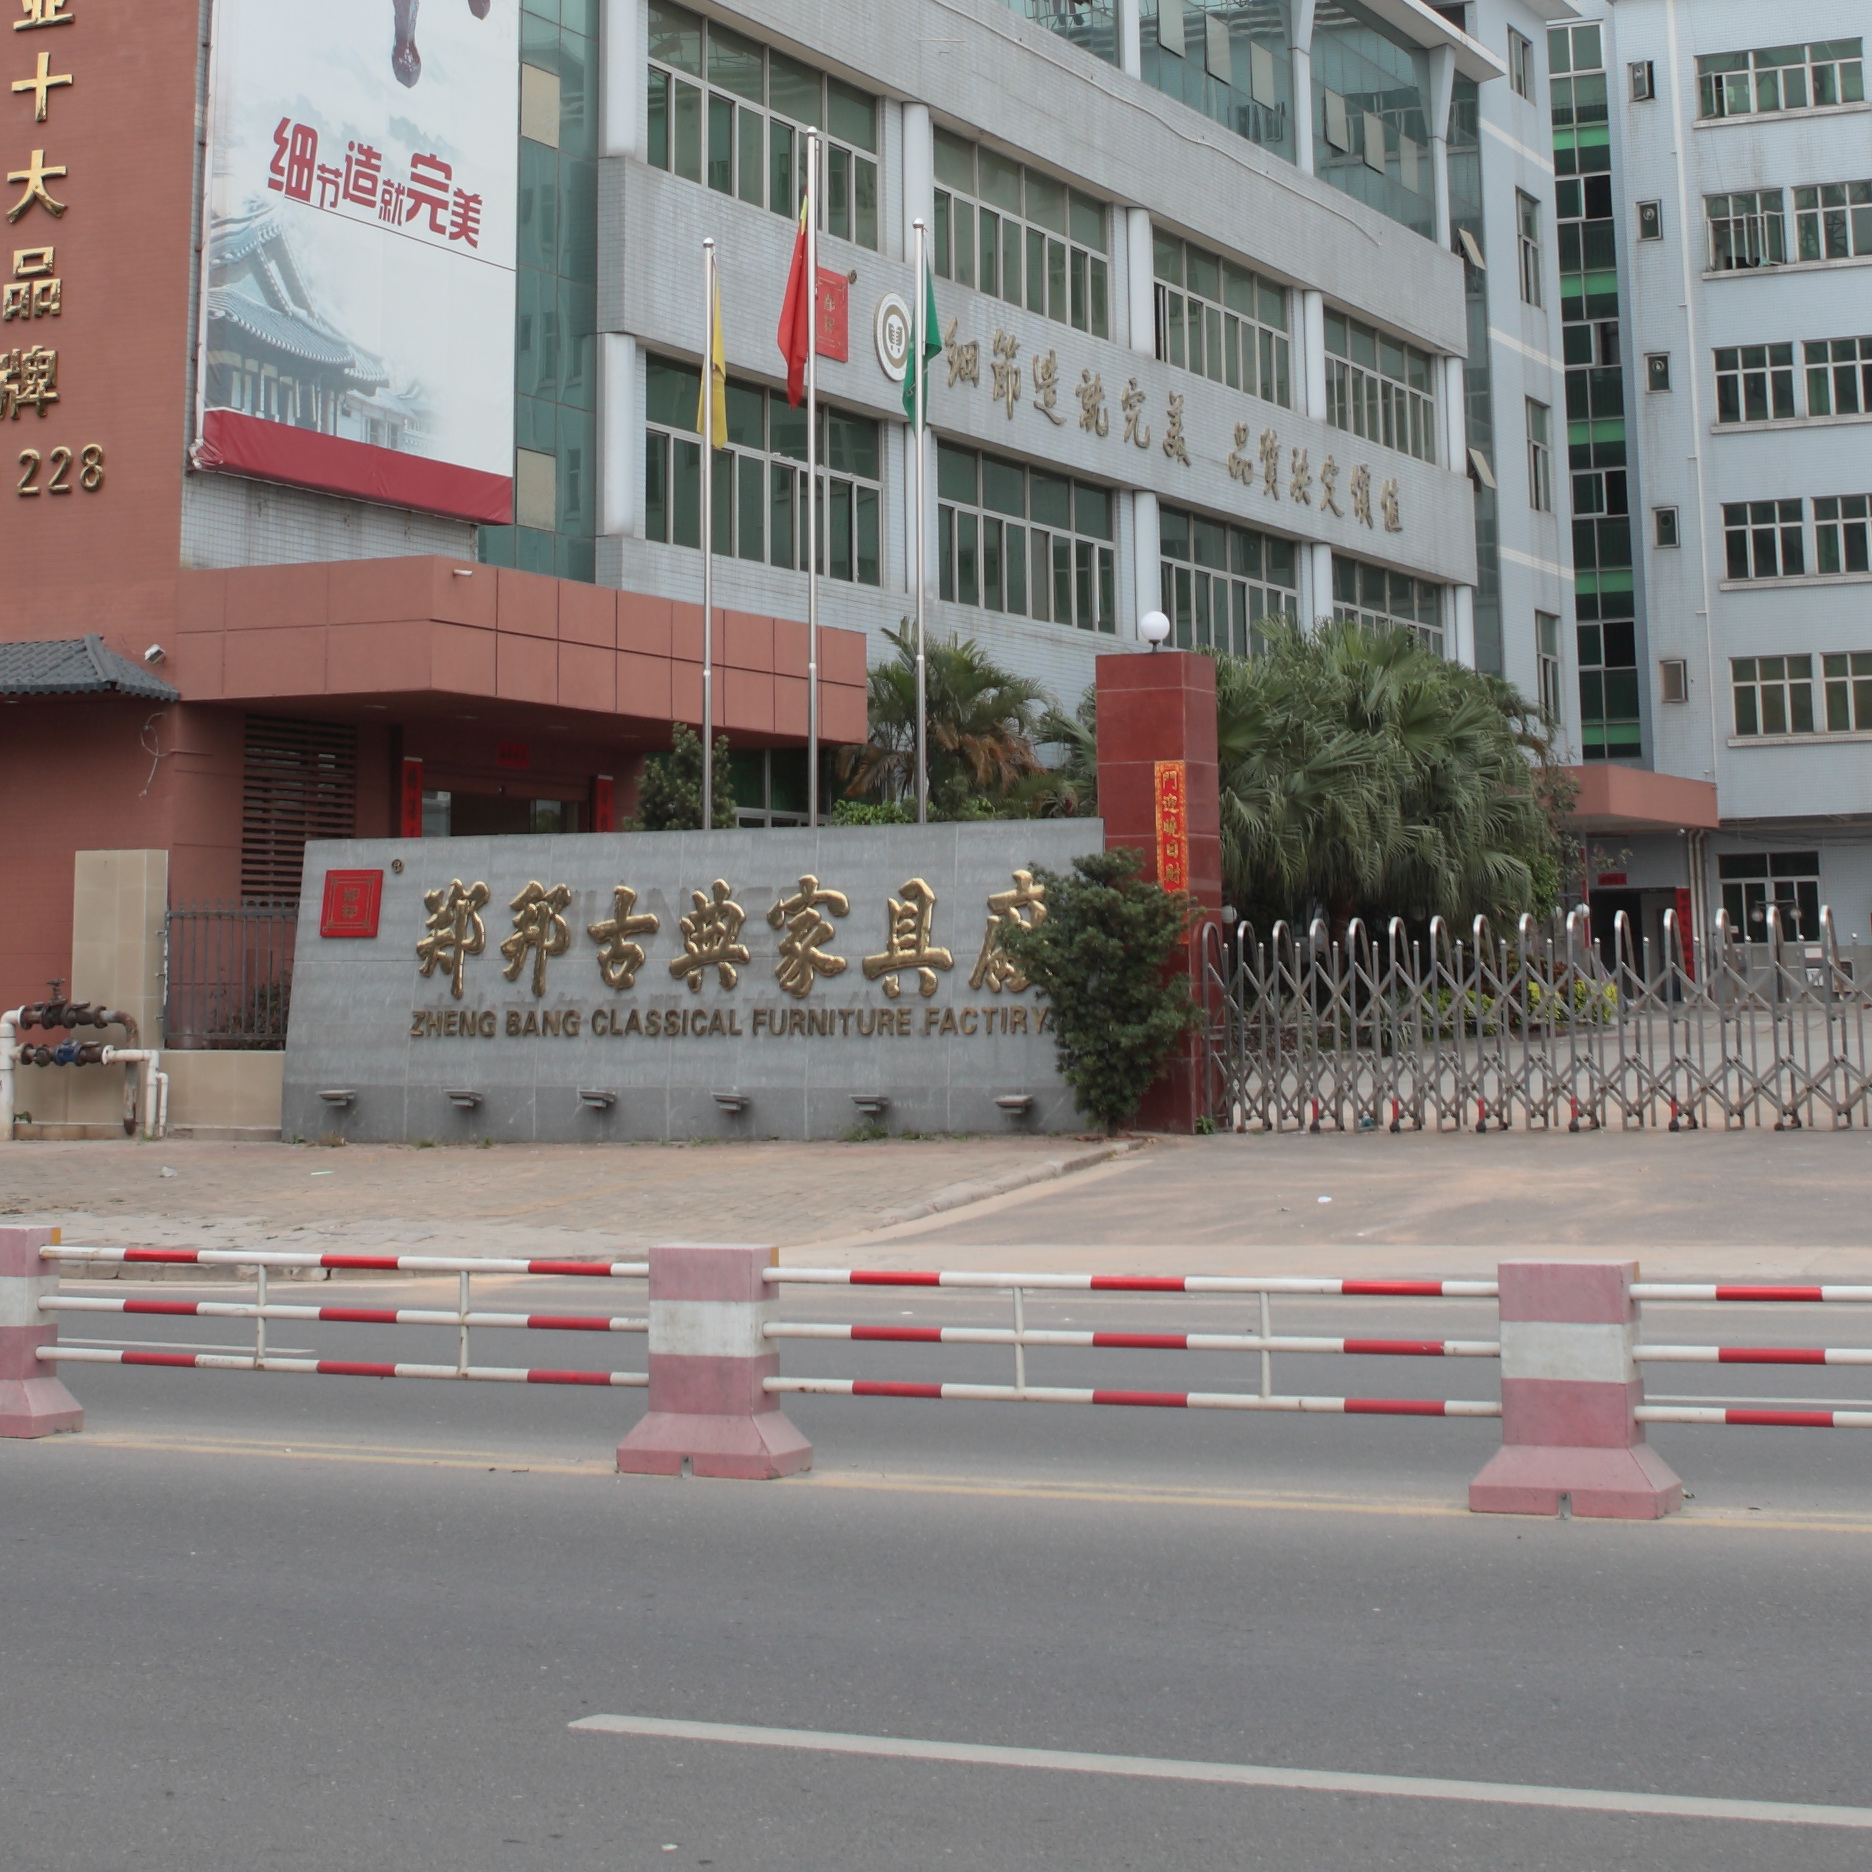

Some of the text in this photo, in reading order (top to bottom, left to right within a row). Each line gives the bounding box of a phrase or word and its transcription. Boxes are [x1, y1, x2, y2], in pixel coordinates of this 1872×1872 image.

[267, 116, 483, 249] 细节造就完美
[17, 443, 105, 496] 228
[410, 1009, 497, 1037] ZHENG
[505, 1009, 581, 1036] BANG
[591, 1008, 743, 1036] CLASSICAL
[752, 1007, 912, 1036] FURNITURE
